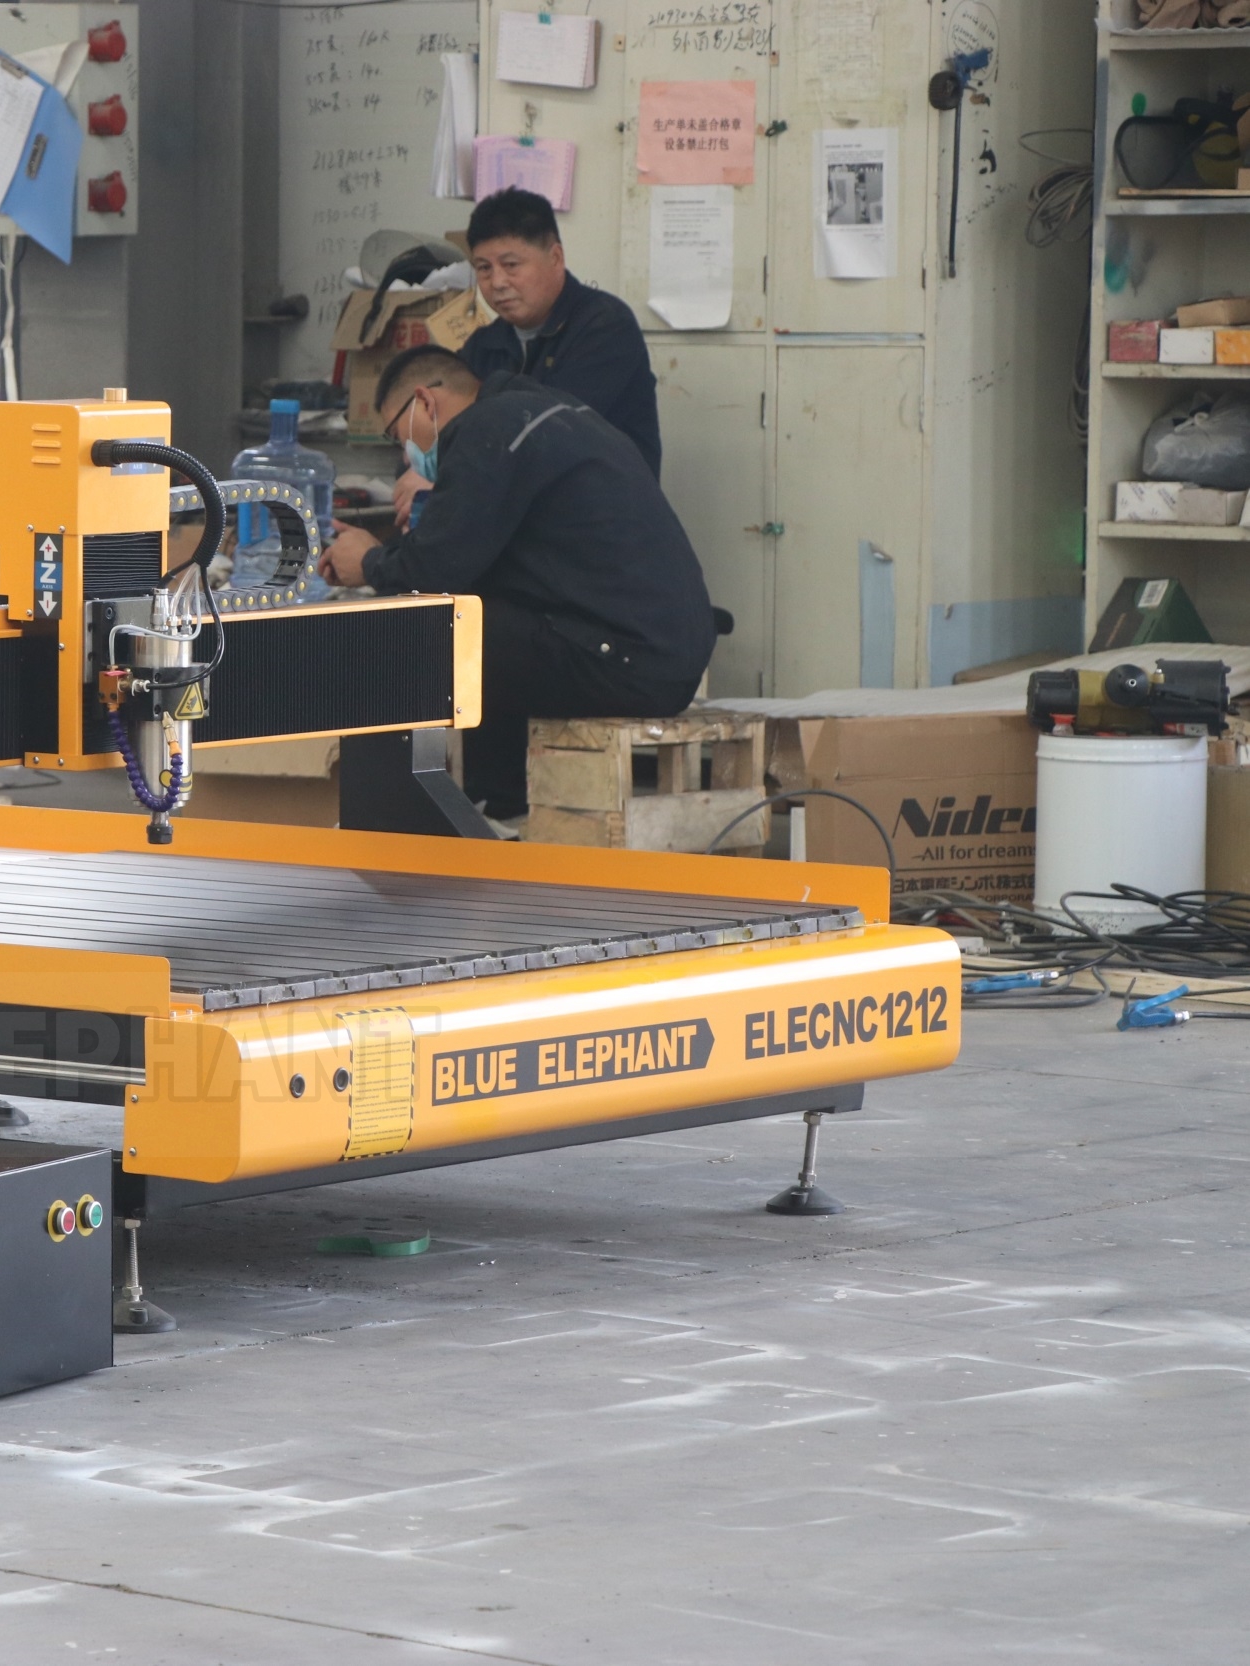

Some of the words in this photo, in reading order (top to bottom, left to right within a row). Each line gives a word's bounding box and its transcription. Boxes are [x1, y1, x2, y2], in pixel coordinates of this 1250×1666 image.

[654, 118, 742, 132] 生产单未盖合格章
[665, 137, 729, 151] 设备禁止打包
[40, 563, 56, 584] Z
[950, 845, 974, 860] for
[745, 986, 947, 1061] ELECNC1212
[435, 1048, 517, 1100] BLUE
[538, 1024, 697, 1086] ELEPHANT
